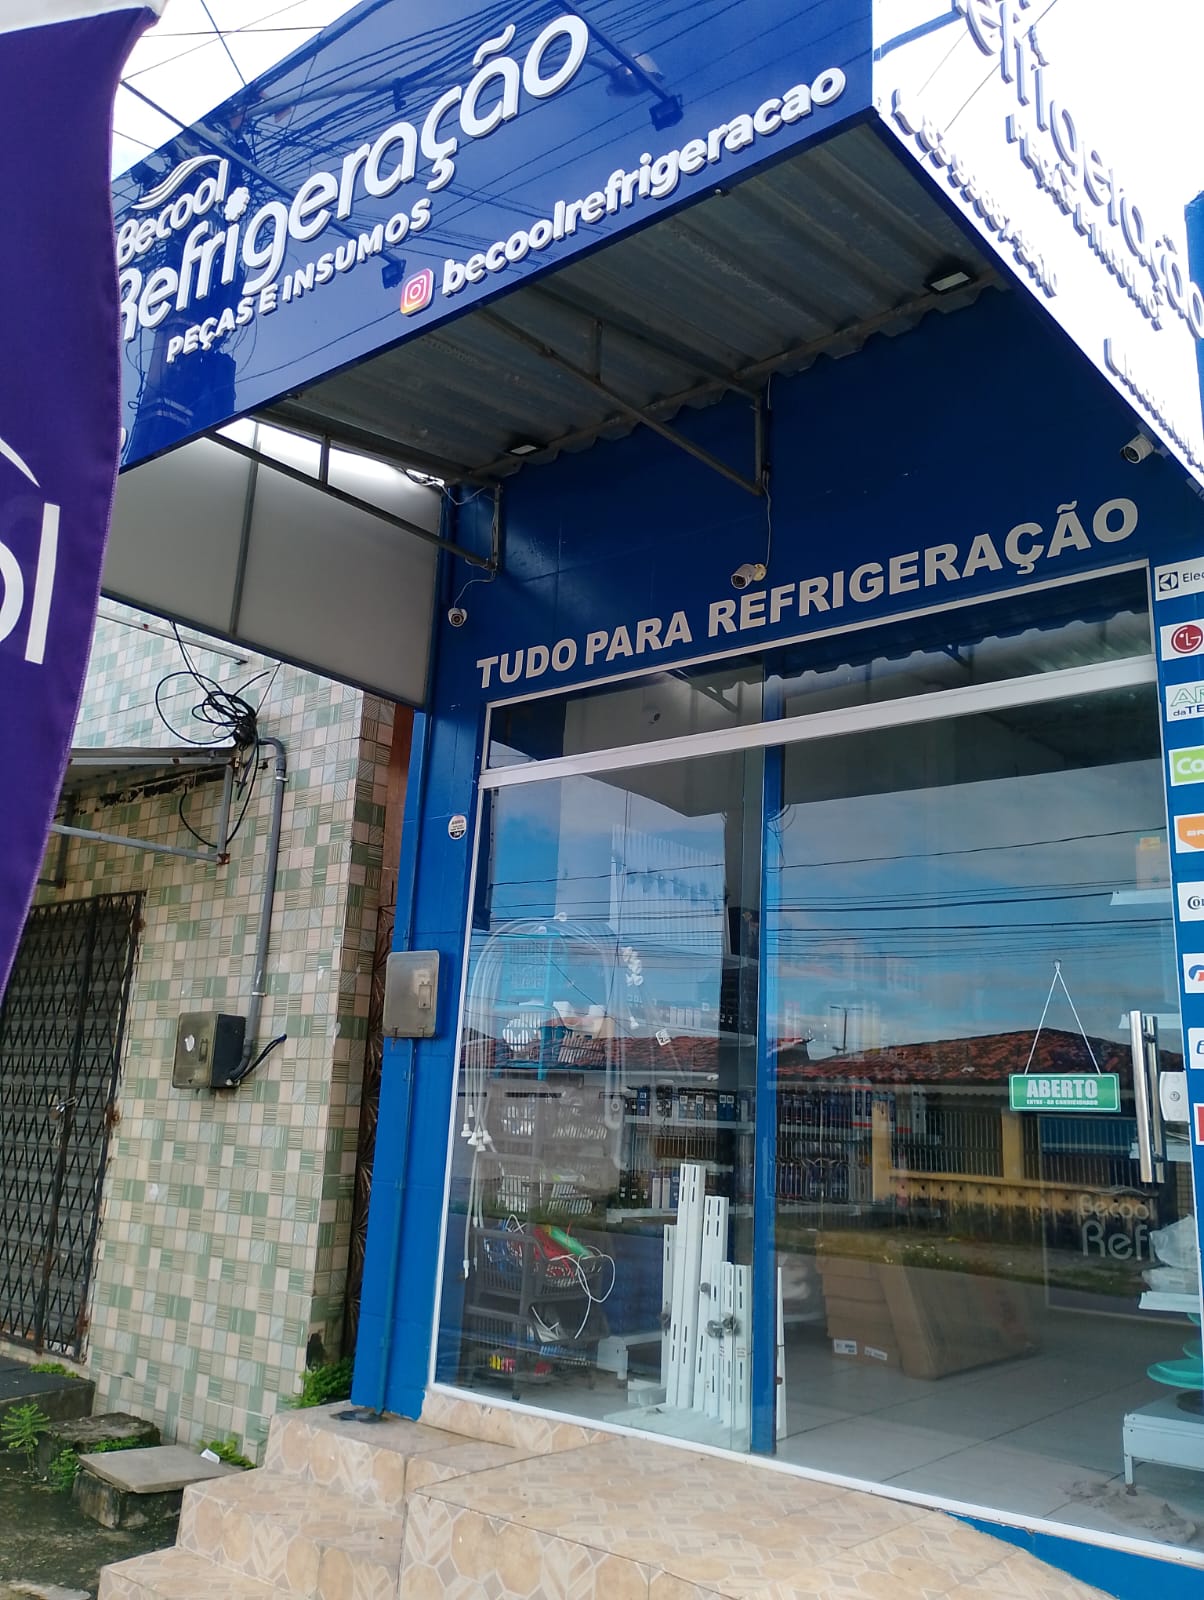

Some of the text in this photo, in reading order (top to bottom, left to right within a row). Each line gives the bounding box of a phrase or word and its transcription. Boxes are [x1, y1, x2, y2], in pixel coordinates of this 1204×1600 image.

[117, 158, 229, 268] Becool
[441, 66, 848, 297] becoolrefrigeracao
[166, 197, 432, 364] PEÇAS E INSUMOS
[476, 497, 1139, 690] TUDO PARA REFRIGERAÇÃO
[1026, 1079, 1099, 1099] ABERTO
[1080, 1194, 1154, 1220] Becool
